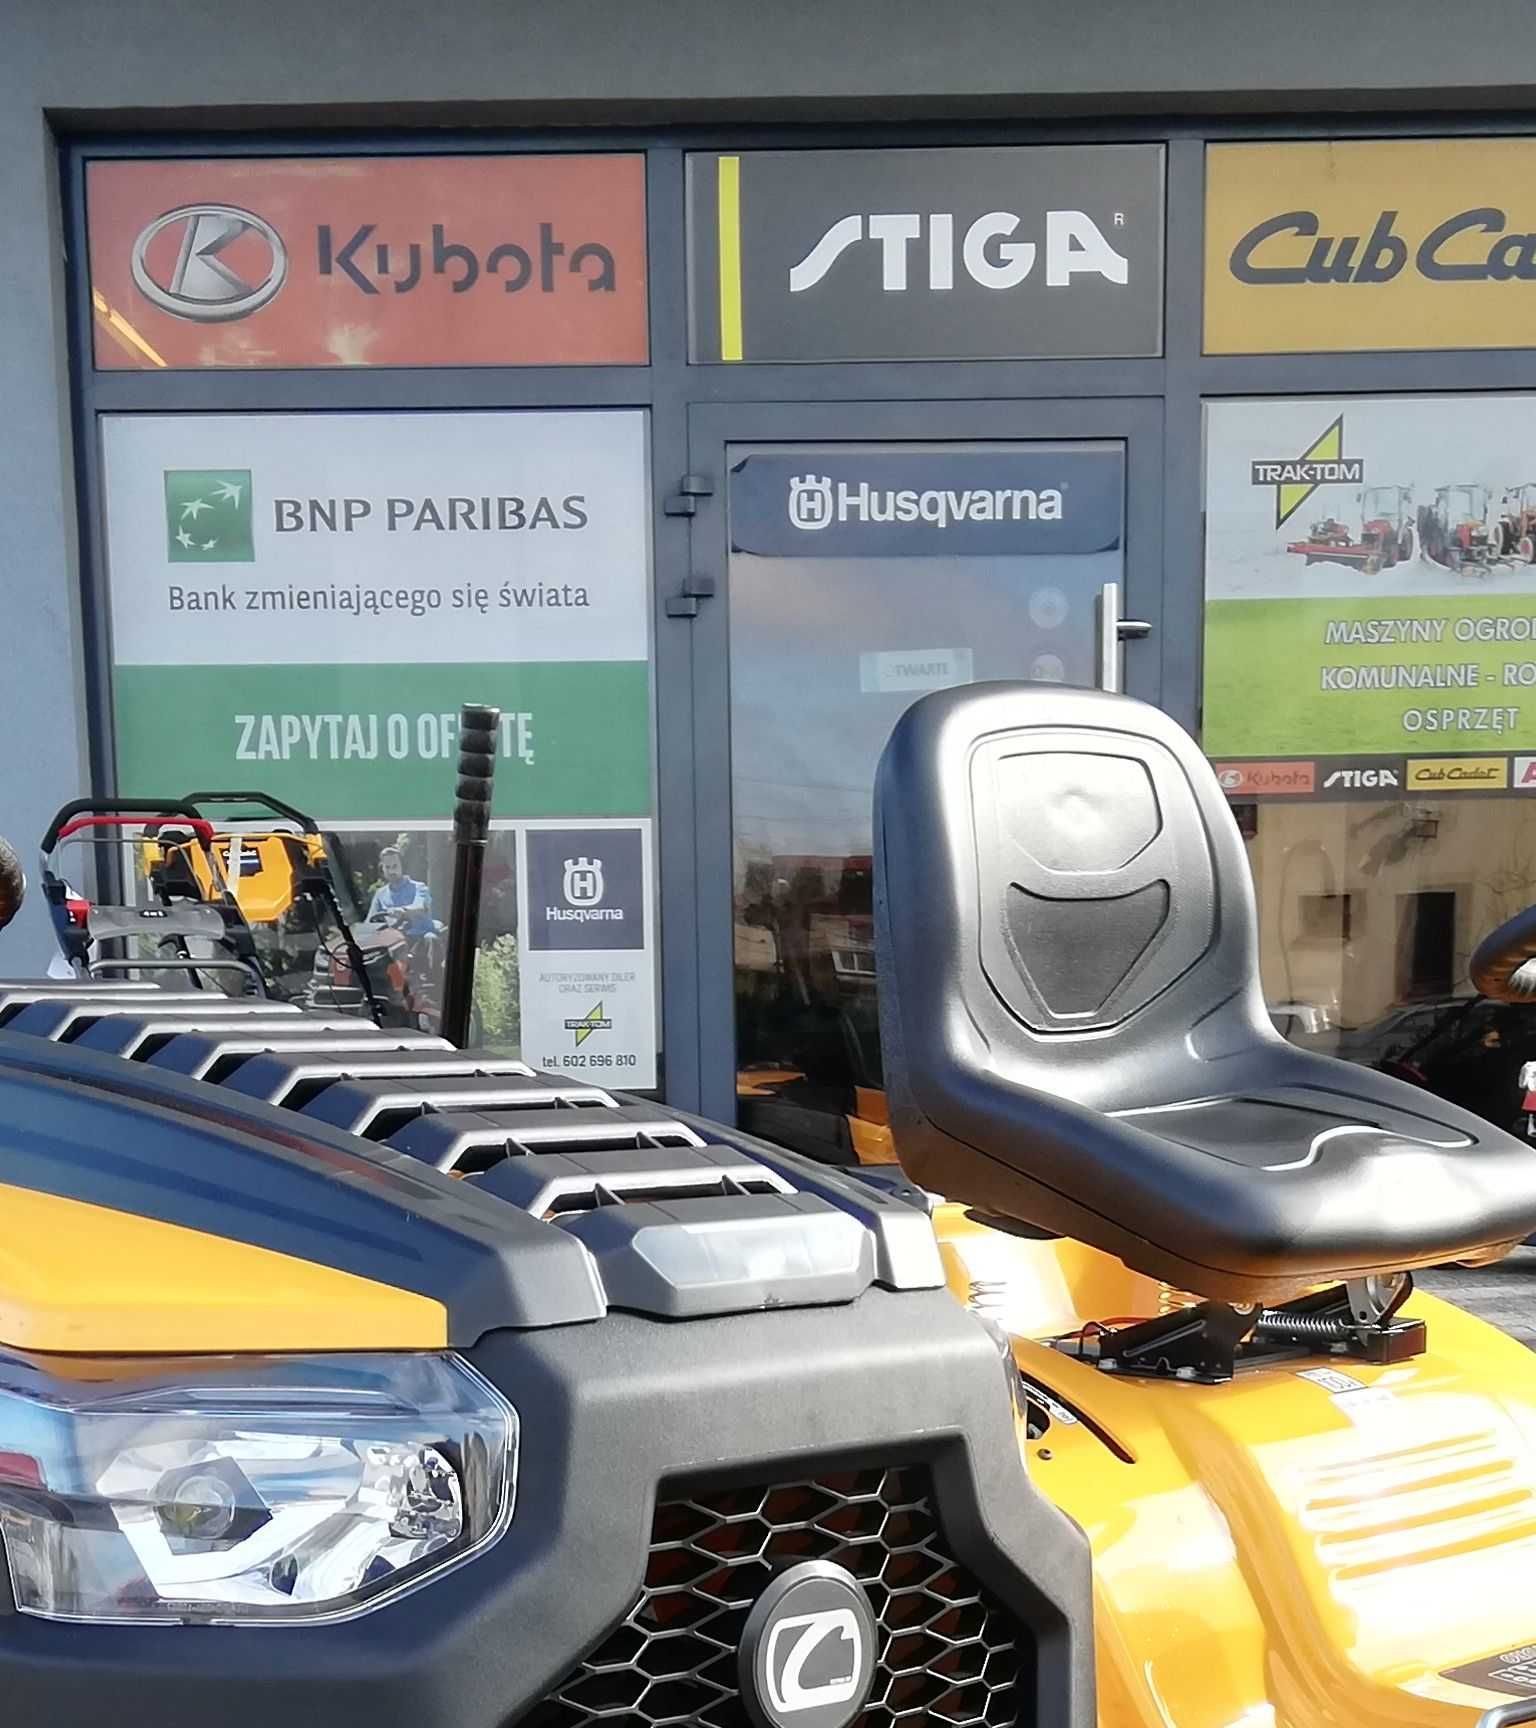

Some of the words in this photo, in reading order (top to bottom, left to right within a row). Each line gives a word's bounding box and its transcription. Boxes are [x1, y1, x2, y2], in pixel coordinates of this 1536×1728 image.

[317, 222, 617, 294] Kubota
[790, 210, 1128, 291] STIGA
[1229, 210, 1407, 284] Cub
[1255, 462, 1360, 484] TRAK-TOM
[274, 497, 371, 533] BNP
[386, 495, 589, 532] PARIBAS
[838, 481, 1063, 527] Husqvarna
[168, 585, 237, 610] Bank
[245, 583, 441, 615] zmieniającego
[451, 582, 490, 614] się
[498, 580, 590, 608] świata
[1325, 617, 1448, 644] MASZYNY
[885, 662, 949, 678] TWARTE
[1321, 664, 1480, 690] KOMUNALNE
[1403, 706, 1520, 737] OSPRZĘT
[234, 714, 378, 761] ZAPYTAJ
[387, 714, 409, 759] O
[418, 712, 535, 766] OFTĘ
[1247, 770, 1309, 786] Kubota
[1323, 769, 1399, 788] STIGA
[1415, 768, 1445, 781] Cub
[546, 907, 624, 923] Husqvarna
[542, 1056, 560, 1067] tel.
[563, 1056, 585, 1067] 602
[590, 1055, 612, 1066] 696
[616, 1055, 636, 1066] 810
